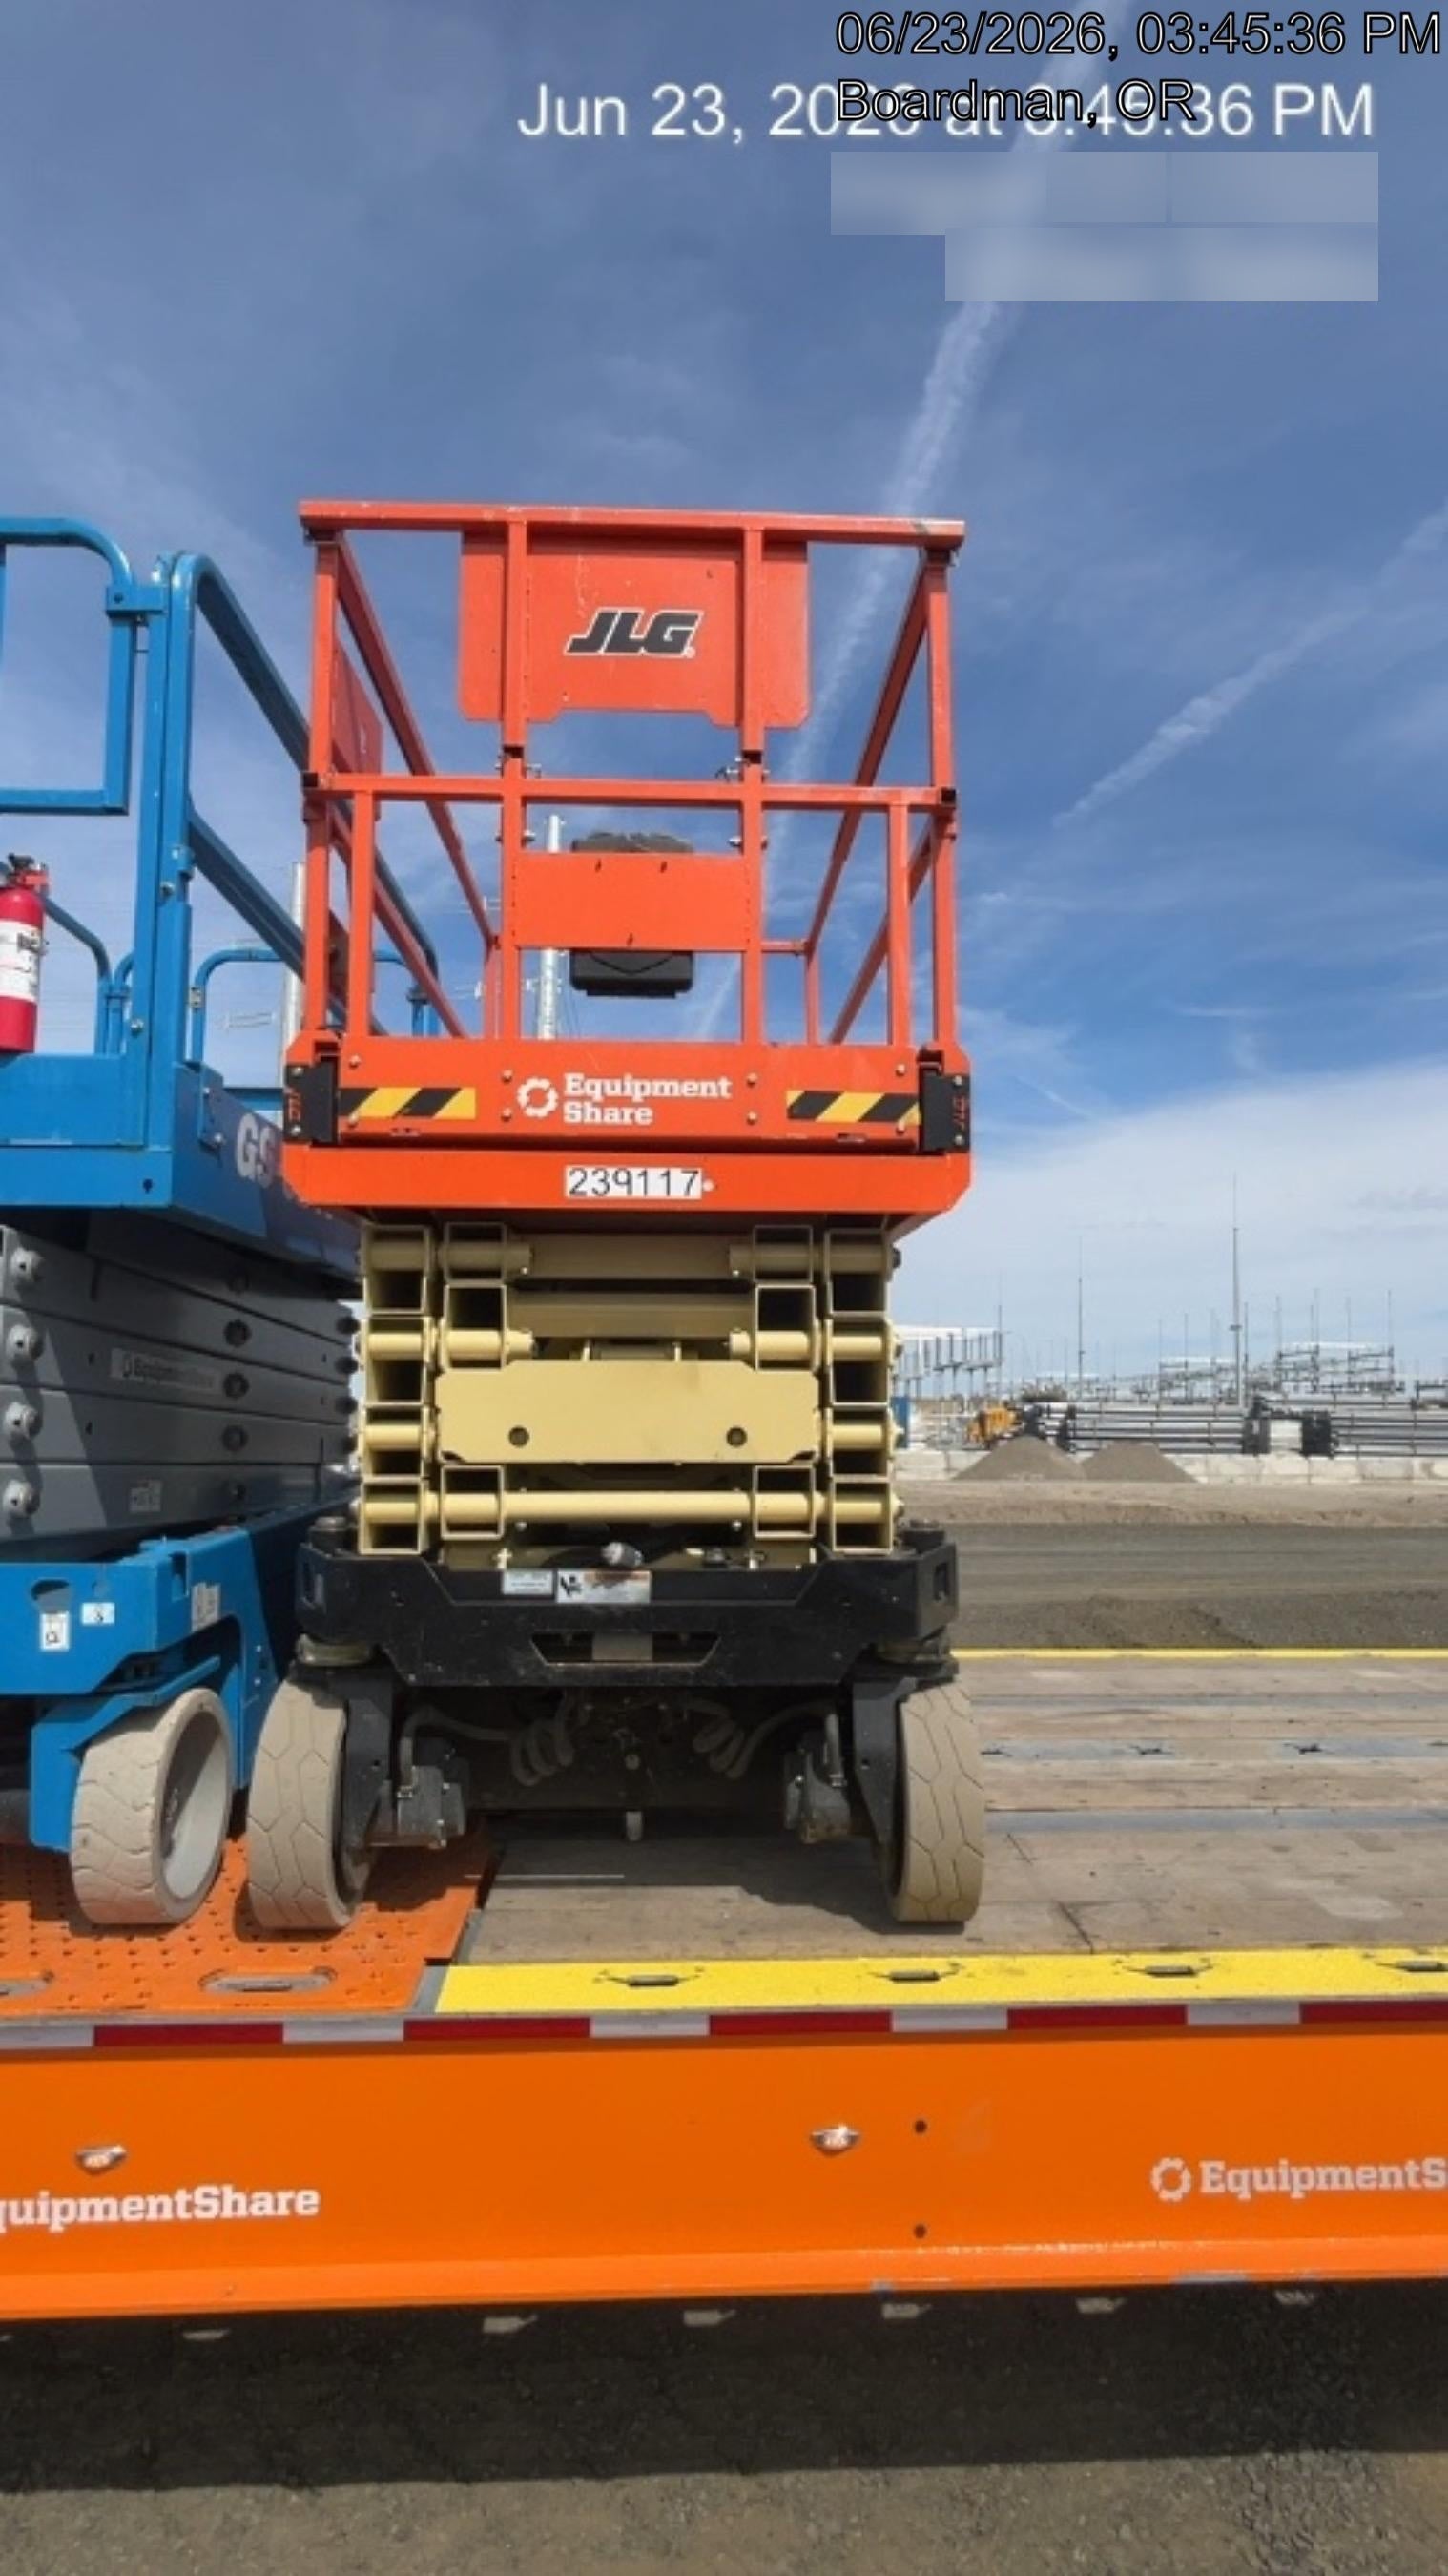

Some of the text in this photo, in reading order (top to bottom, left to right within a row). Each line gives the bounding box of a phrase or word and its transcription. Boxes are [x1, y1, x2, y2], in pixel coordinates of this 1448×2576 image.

[565, 608, 704, 659] JLG
[564, 1072, 733, 1102] Equipment
[563, 1101, 654, 1126] Share
[569, 1167, 699, 1197] 239117
[0, 2185, 321, 2233] uipmentShare
